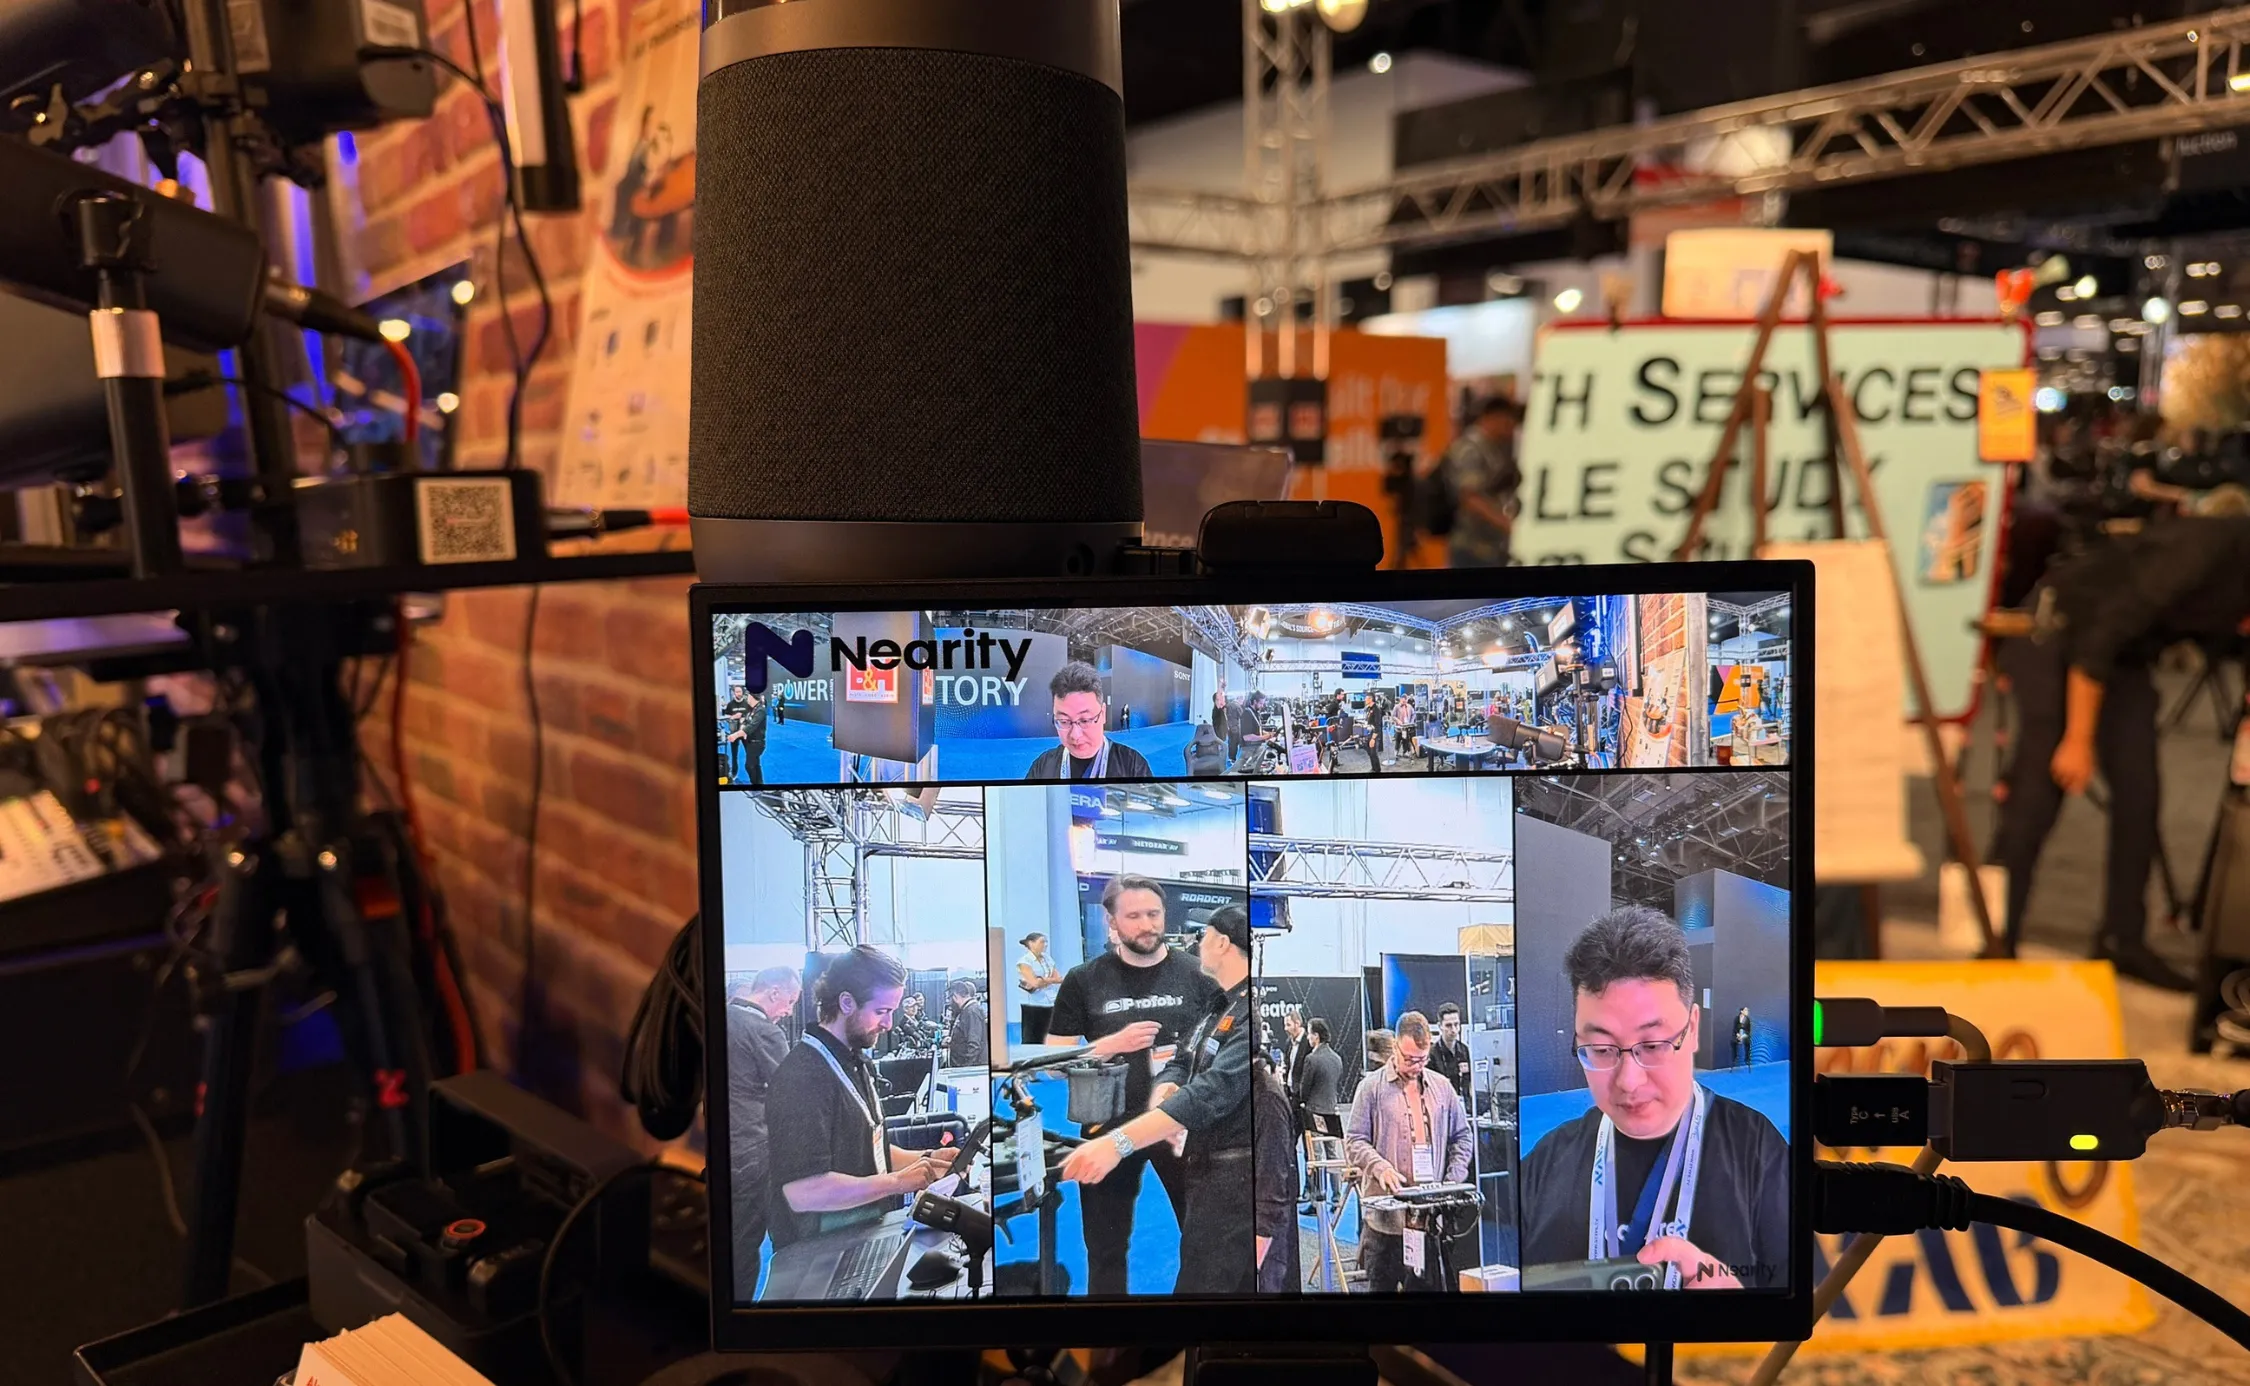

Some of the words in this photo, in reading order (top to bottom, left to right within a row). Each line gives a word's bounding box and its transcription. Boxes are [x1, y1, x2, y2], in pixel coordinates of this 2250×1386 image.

[830, 628, 1033, 682] Nearity
[935, 675, 1028, 706] TORY
[1174, 670, 1191, 681] SONY
